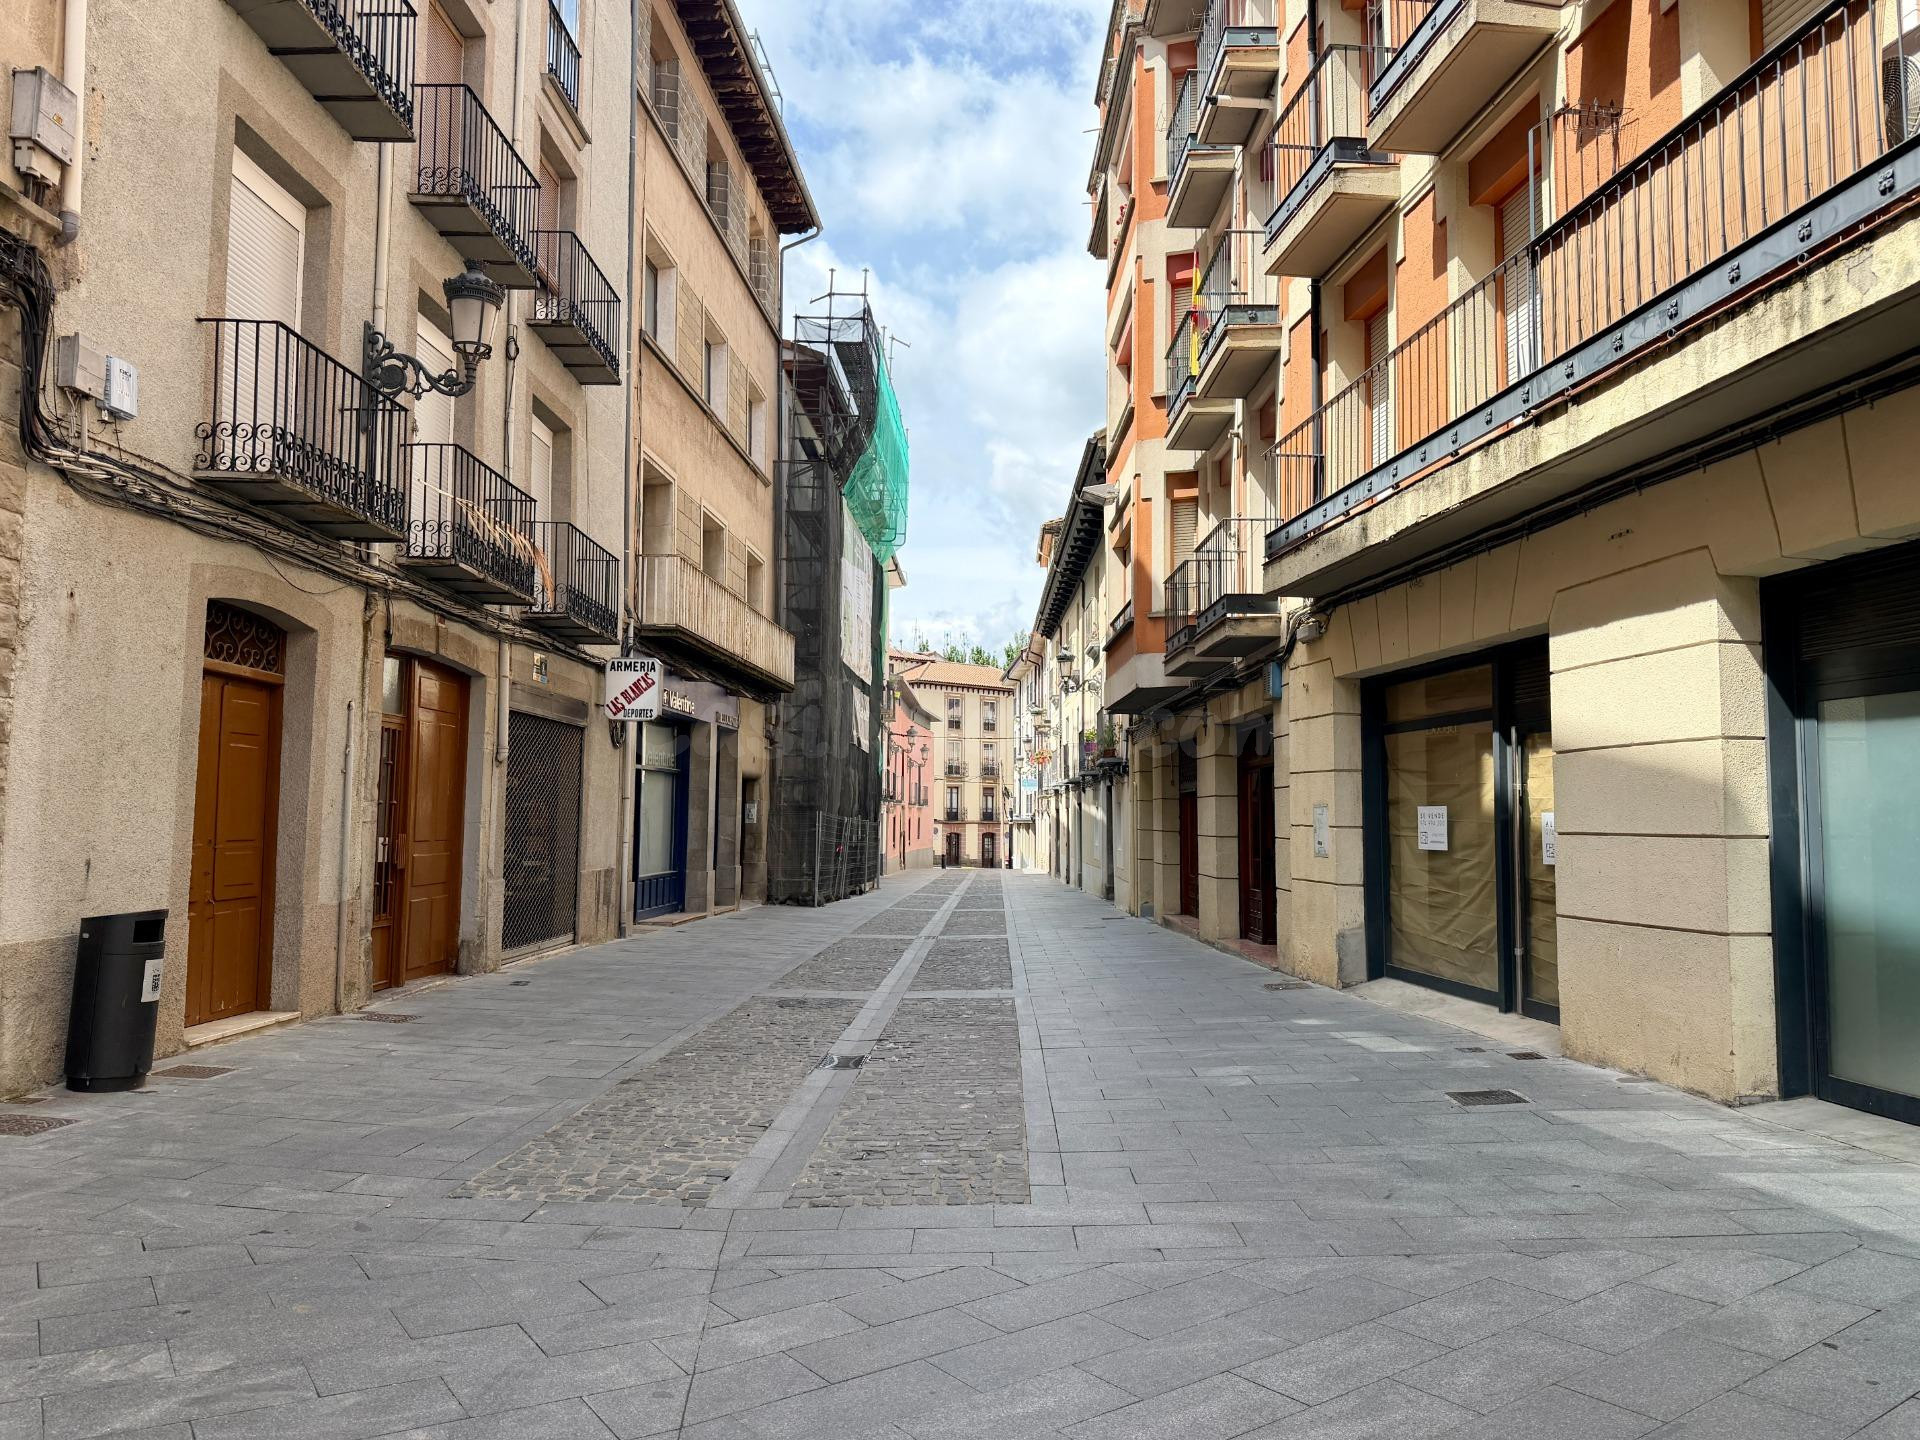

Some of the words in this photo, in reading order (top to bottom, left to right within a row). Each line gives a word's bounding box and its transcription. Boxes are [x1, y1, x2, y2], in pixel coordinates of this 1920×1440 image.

[609, 660, 656, 673] ARMERIA
[606, 696, 626, 717] LAS
[620, 671, 656, 705] BLANCAS
[669, 690, 695, 715] Valentine
[622, 708, 654, 719] DEPORTES
